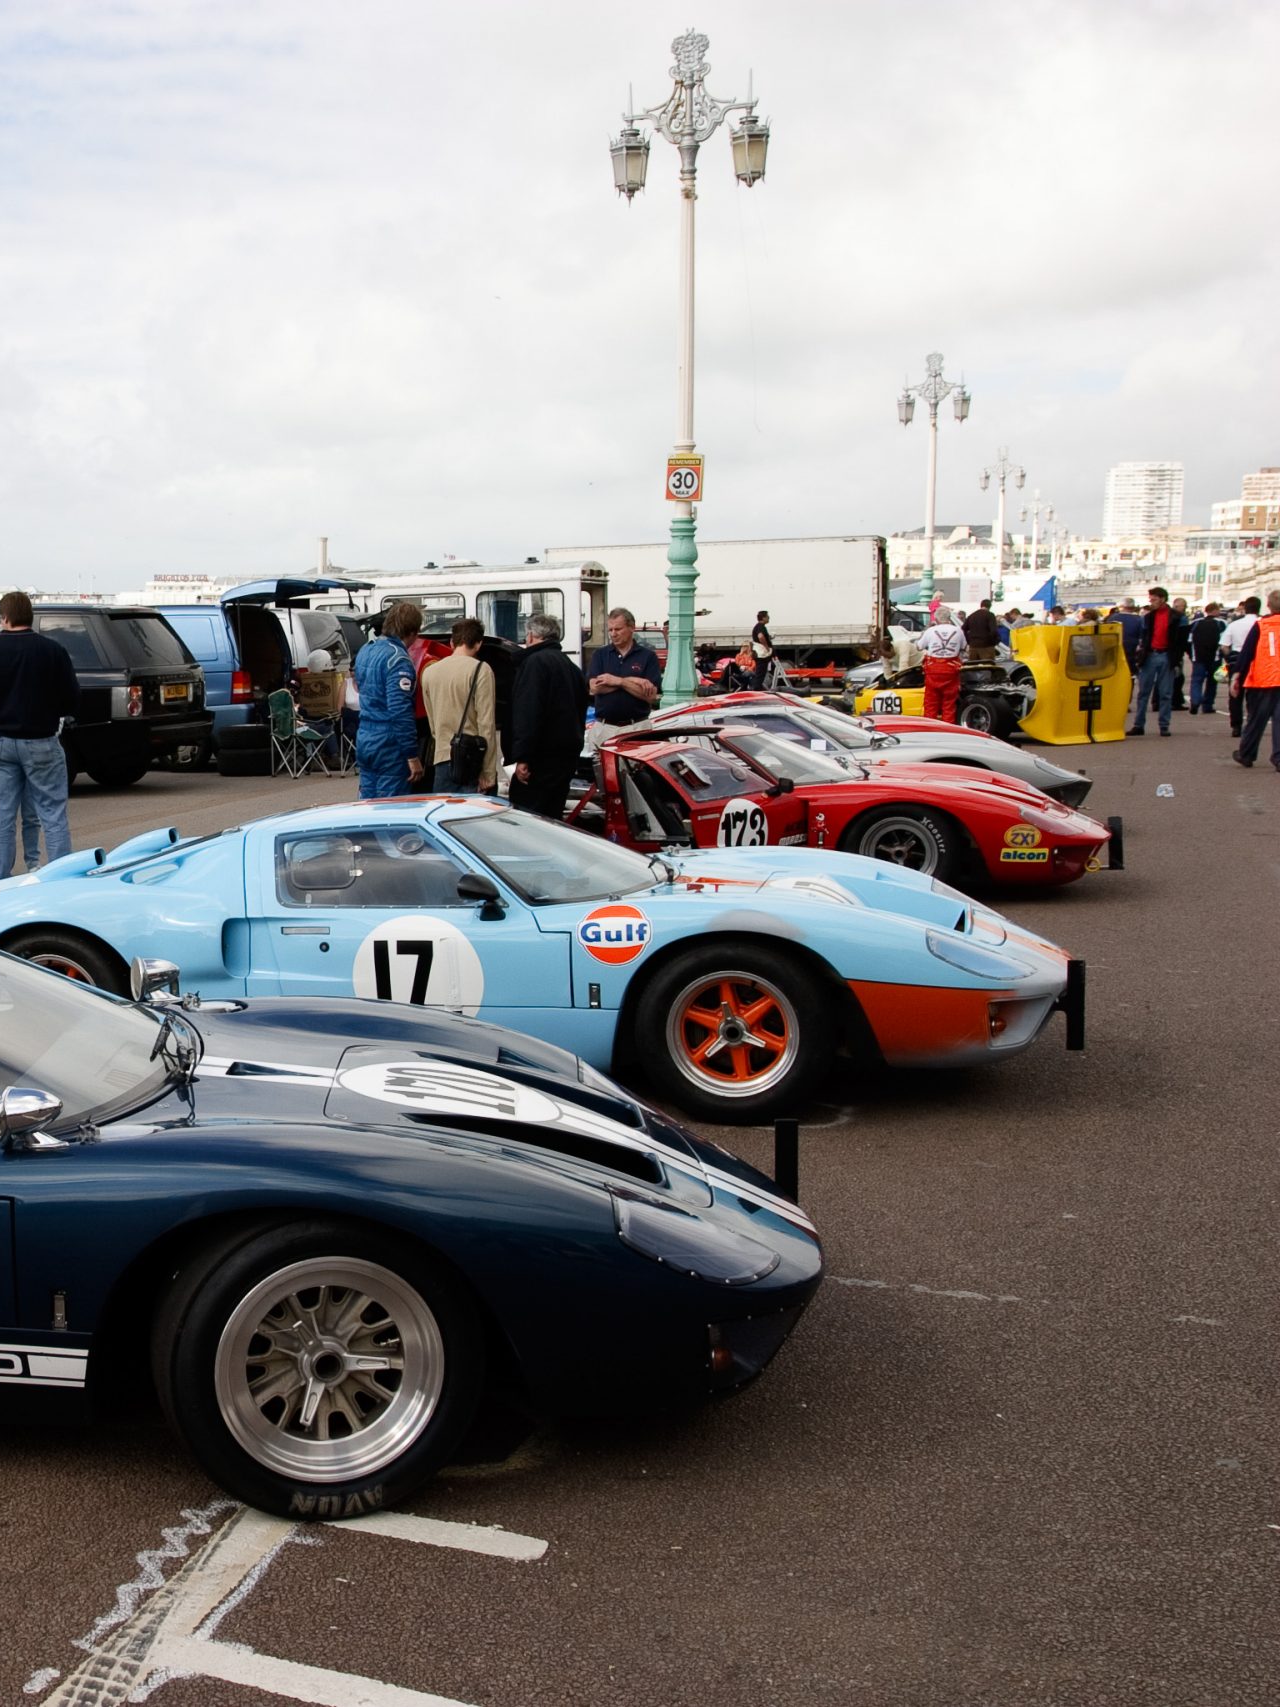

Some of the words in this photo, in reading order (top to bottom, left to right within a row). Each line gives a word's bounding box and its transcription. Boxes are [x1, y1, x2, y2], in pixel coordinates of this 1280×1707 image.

[672, 471, 695, 489] 30
[873, 696, 902, 714] 1789
[721, 807, 766, 846] 173
[1010, 832, 1036, 846] ZX1
[1002, 851, 1047, 860] alcon
[580, 922, 648, 942] Gulf
[373, 940, 434, 1005] 17
